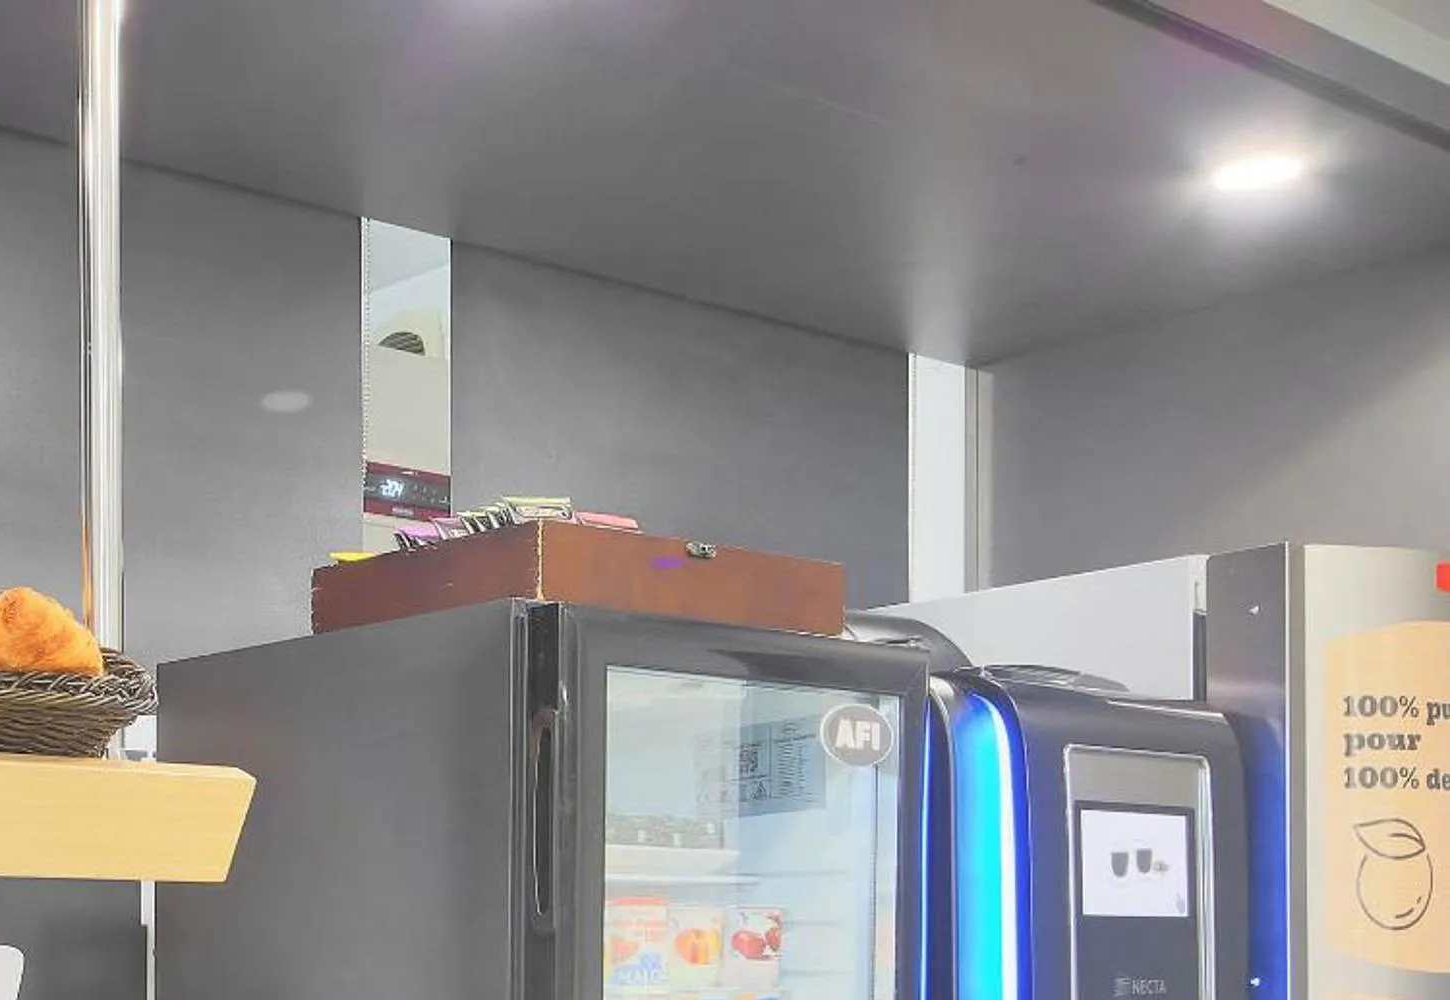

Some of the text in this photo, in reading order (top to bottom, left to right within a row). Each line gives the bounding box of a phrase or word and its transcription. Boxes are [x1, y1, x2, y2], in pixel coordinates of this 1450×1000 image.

[1343, 695, 1419, 717] 100%
[834, 718, 881, 751] AFI
[1343, 733, 1421, 757] pour
[1344, 766, 1419, 789] 100%
[1132, 979, 1166, 995] NECTA
